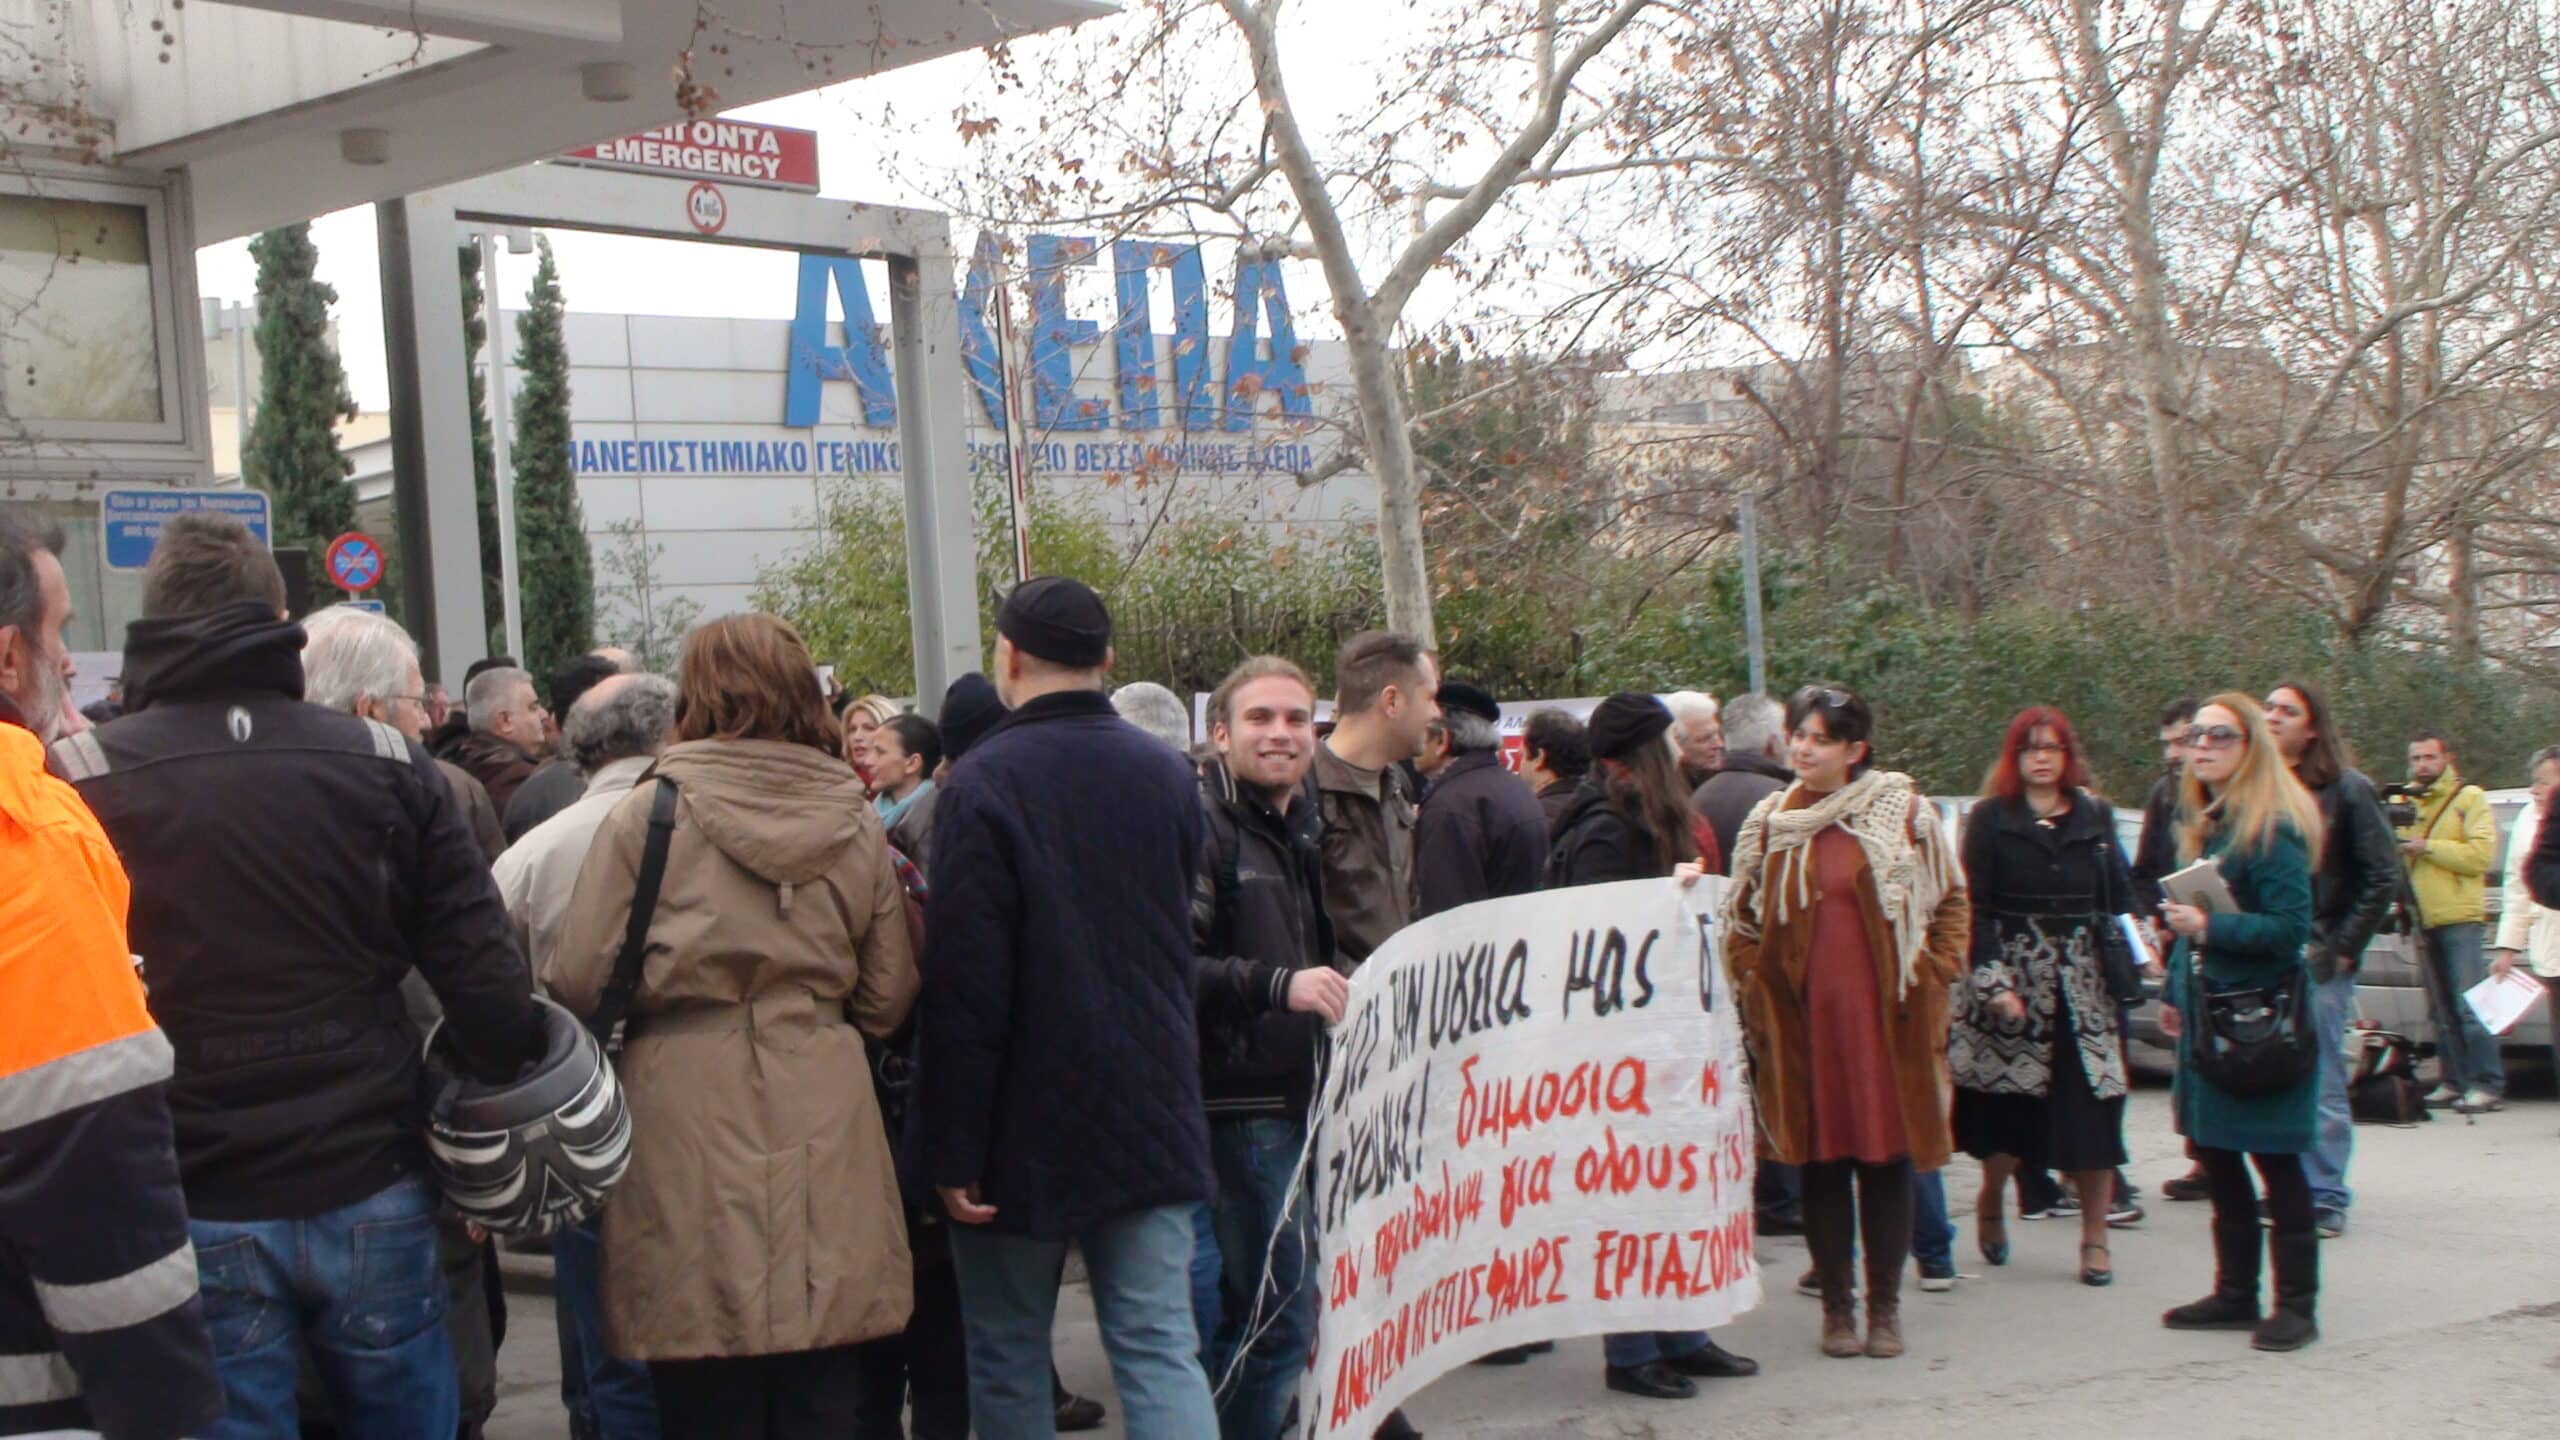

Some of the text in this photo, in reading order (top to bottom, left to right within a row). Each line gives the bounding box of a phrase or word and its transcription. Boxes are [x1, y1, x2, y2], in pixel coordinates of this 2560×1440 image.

[596, 138, 781, 179] EMERGENCY
[1075, 442, 1237, 474] ΘΕΣΣΑΟΝΙΚΗΣ
[1562, 926, 1660, 1022] μας
[1575, 1124, 1699, 1196] ολους
